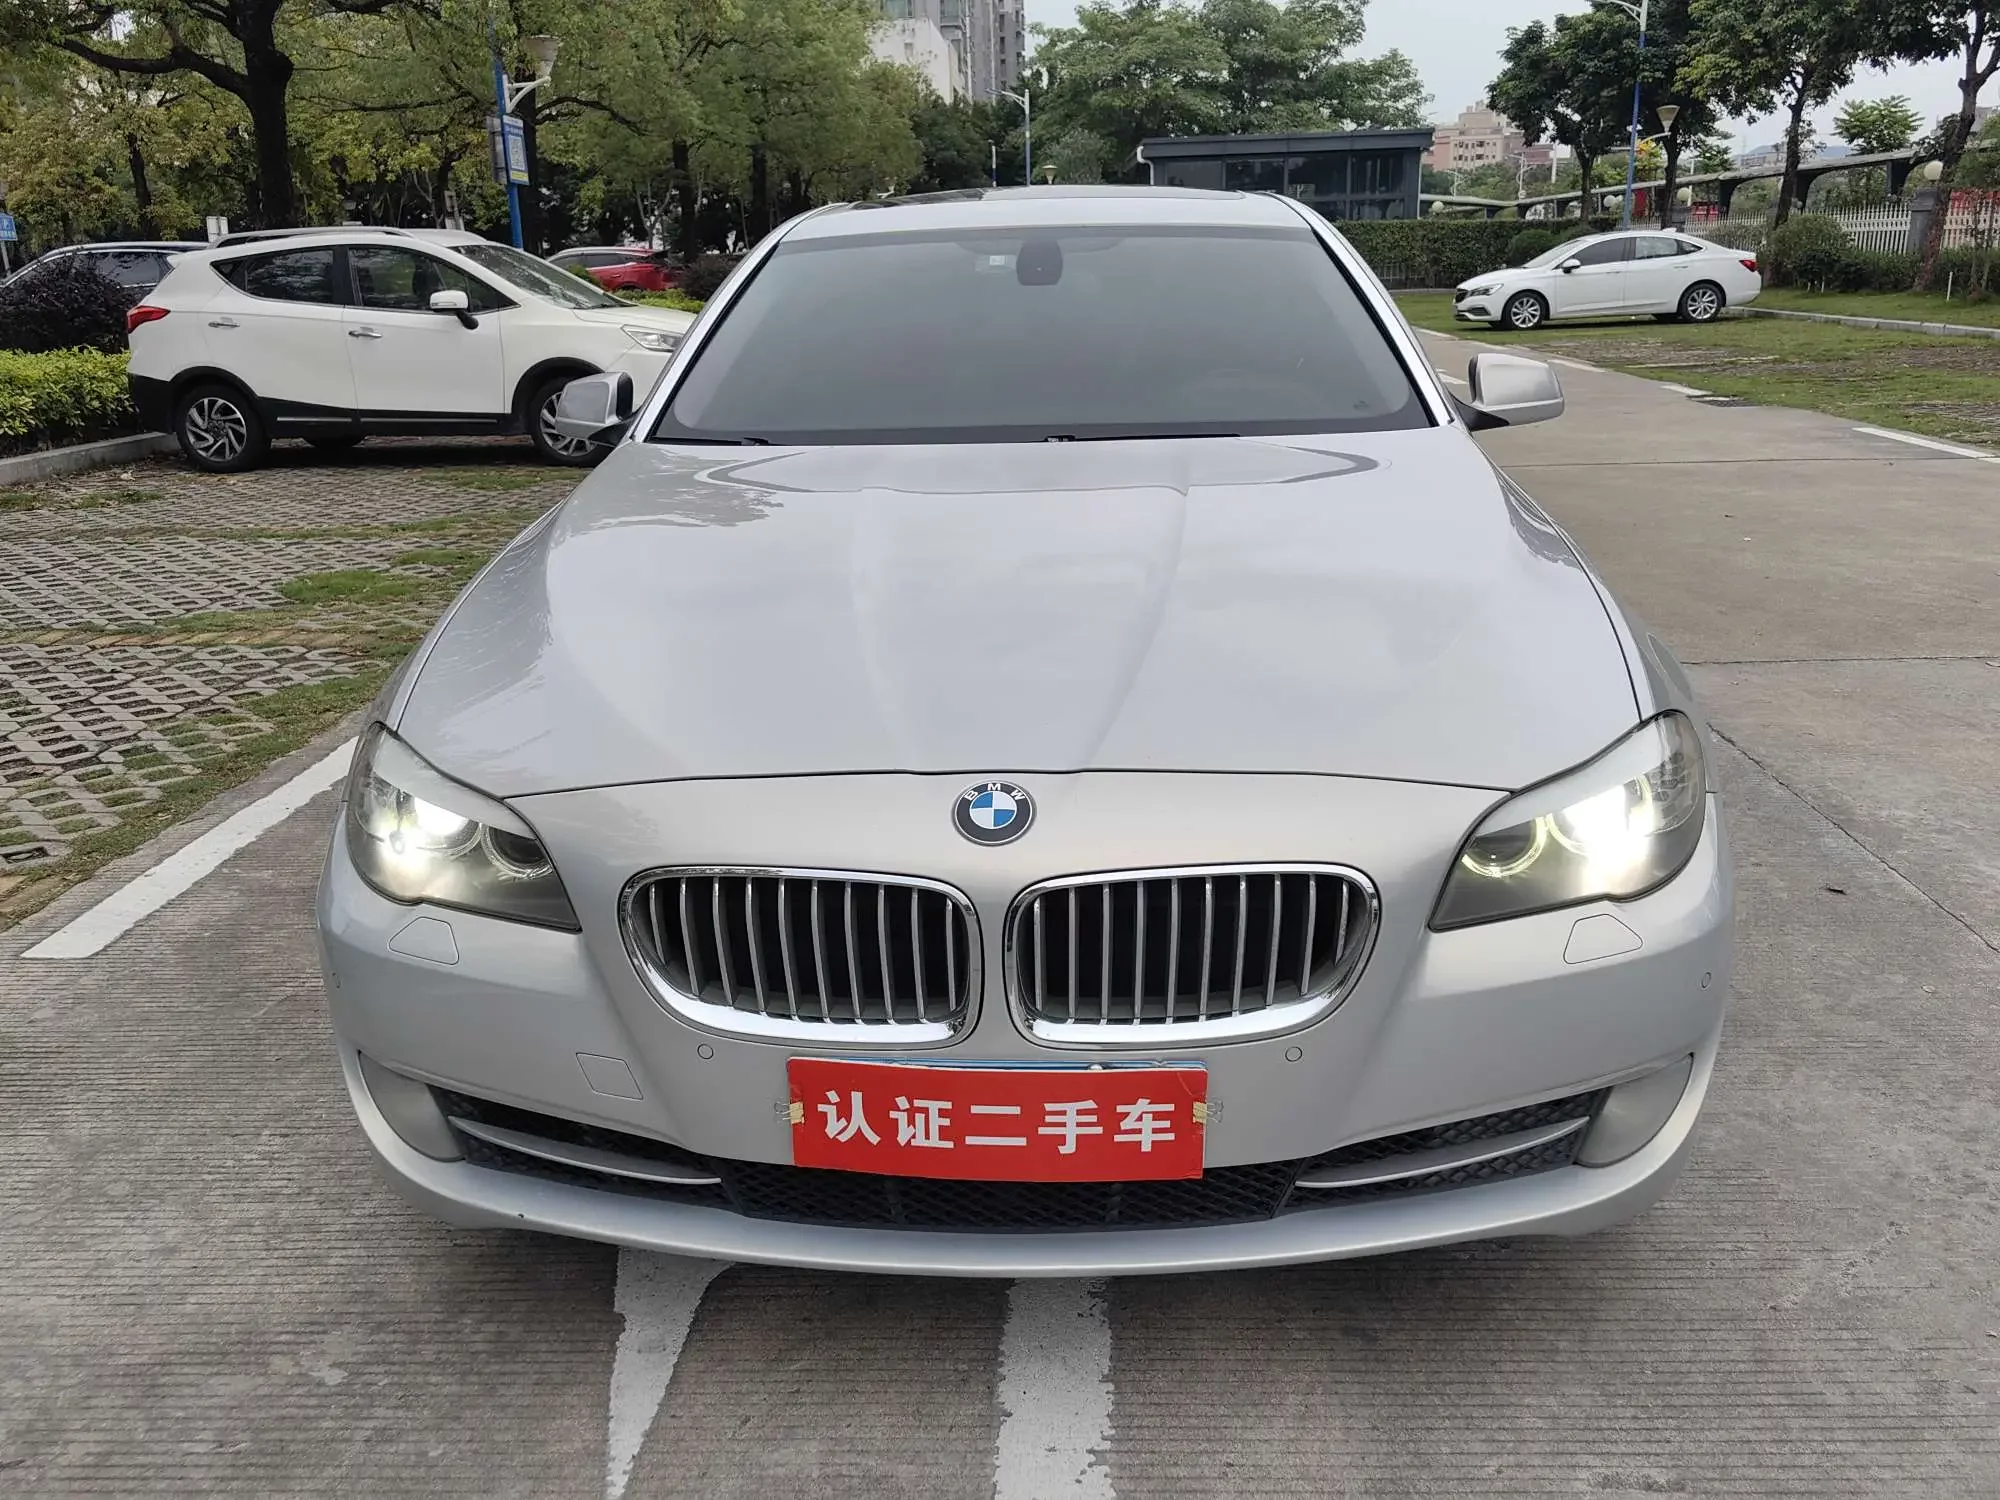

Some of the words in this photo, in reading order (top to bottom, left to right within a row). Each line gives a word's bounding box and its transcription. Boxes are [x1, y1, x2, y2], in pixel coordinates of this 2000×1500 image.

[964, 783, 1025, 801] BMW
[817, 1091, 1175, 1154] 认证二手车
